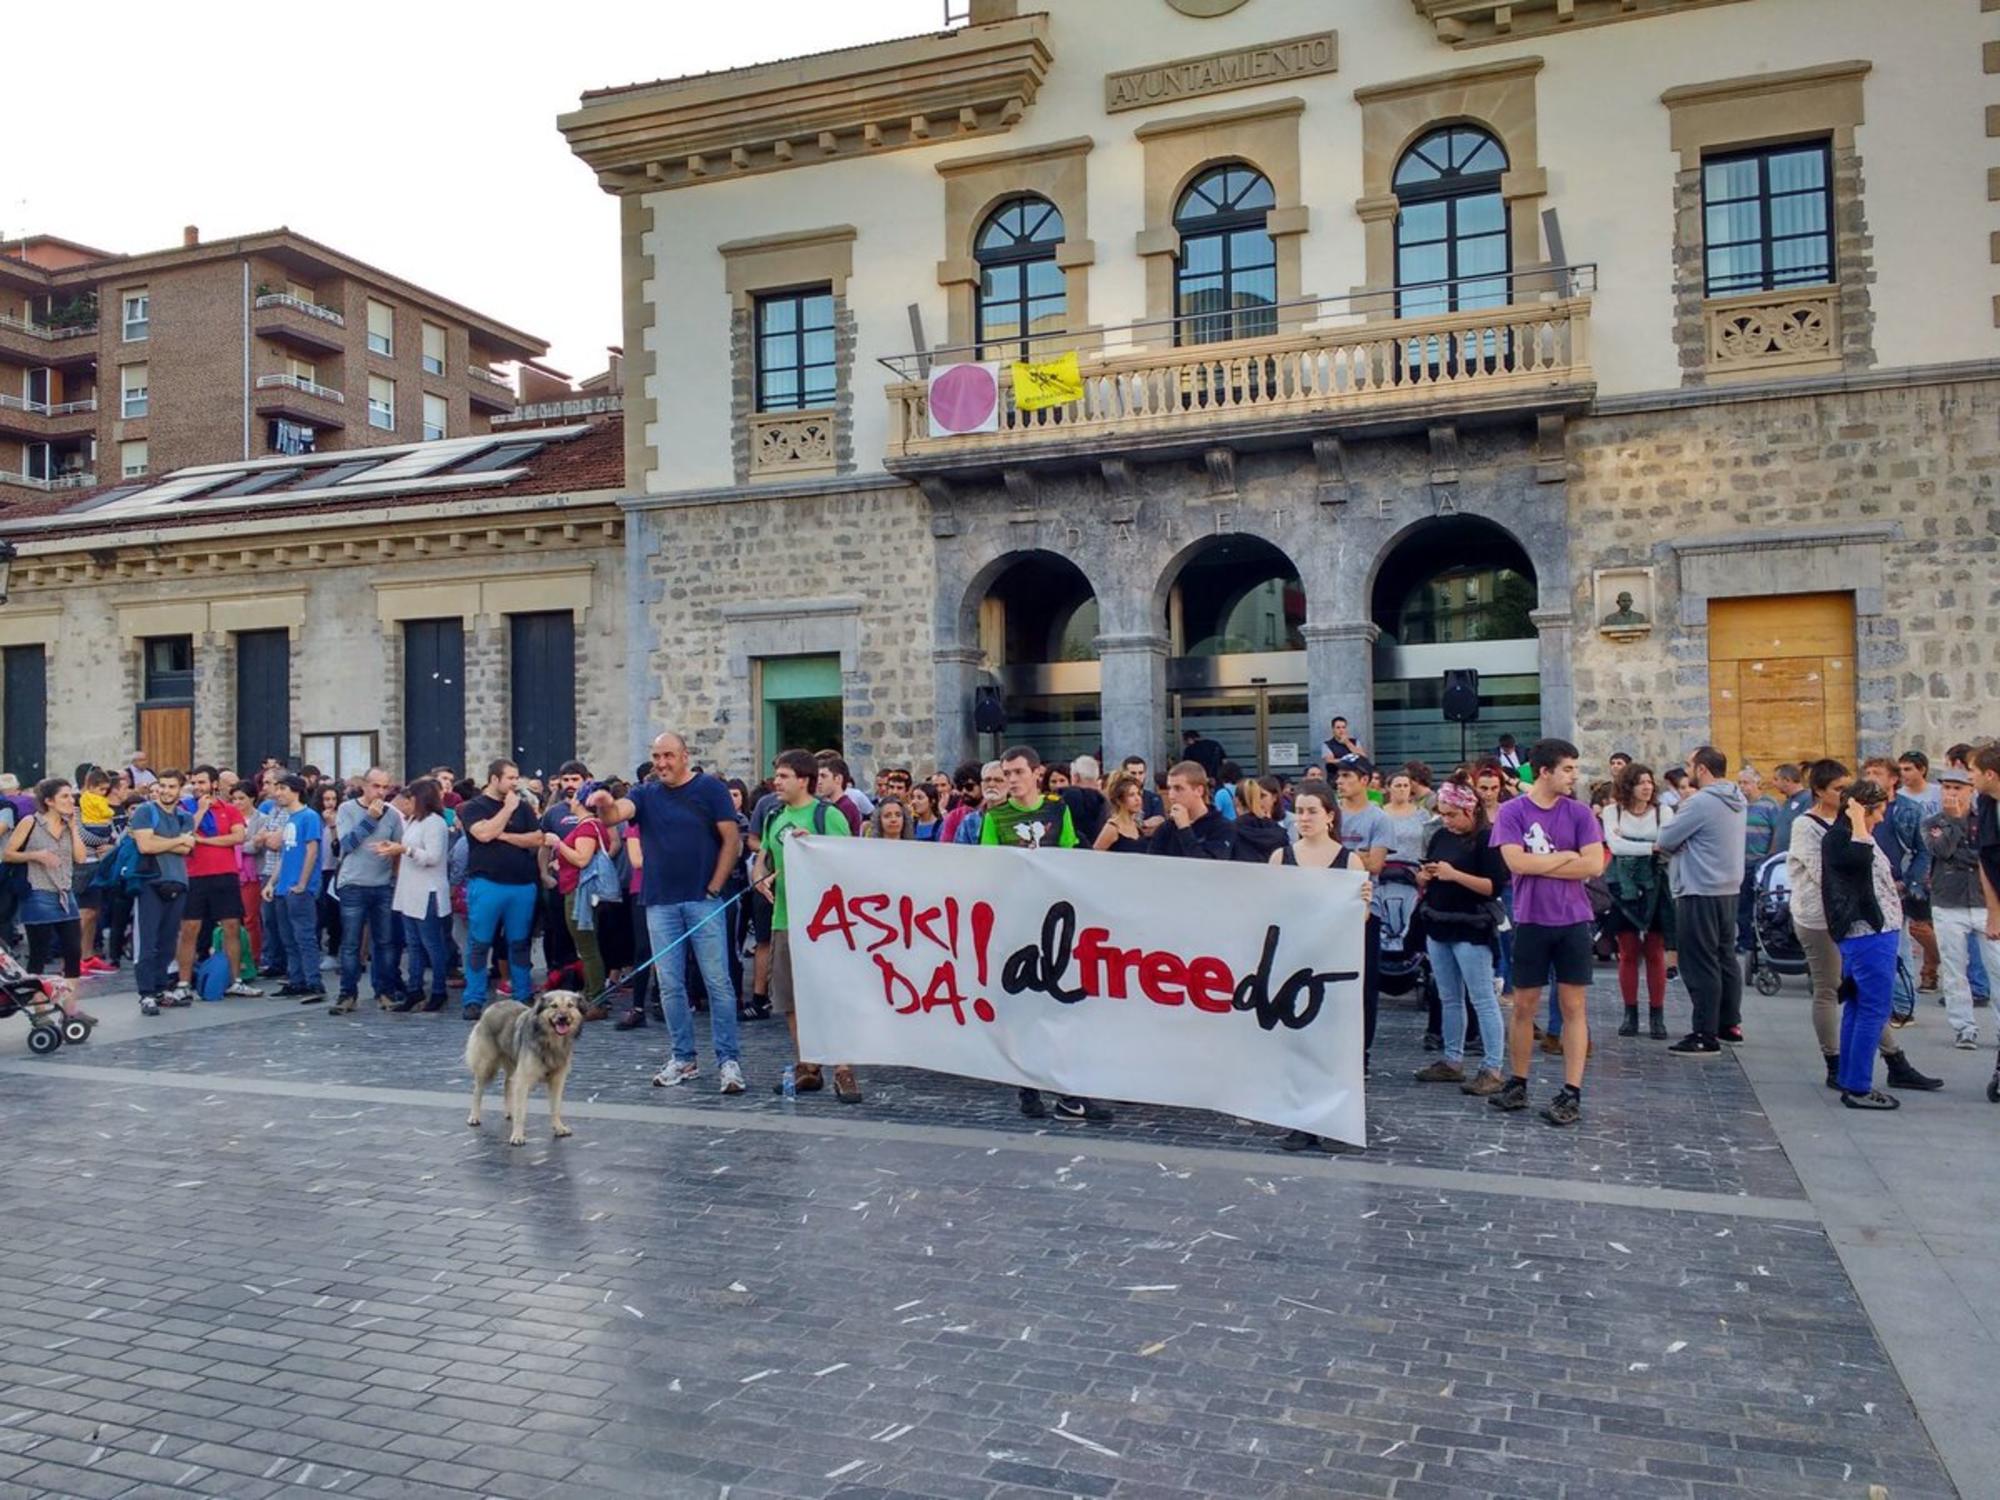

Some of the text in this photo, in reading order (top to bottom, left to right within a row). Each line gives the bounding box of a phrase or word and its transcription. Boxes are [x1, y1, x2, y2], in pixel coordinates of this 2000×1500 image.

[1111, 40, 1330, 106] AYUNTAMIENTO
[806, 884, 960, 956] ASKI
[1001, 900, 1360, 1031] alfreedo
